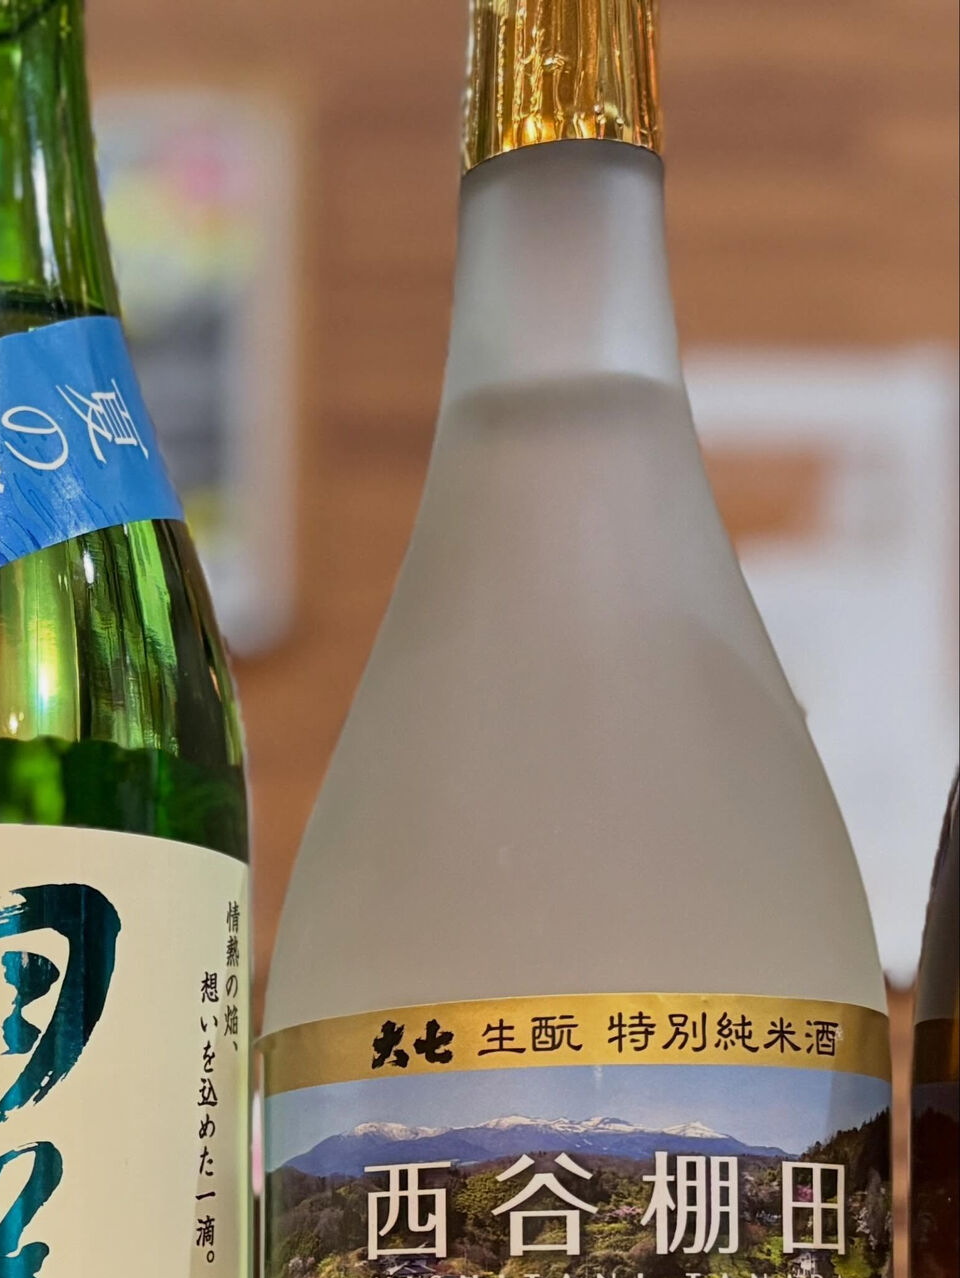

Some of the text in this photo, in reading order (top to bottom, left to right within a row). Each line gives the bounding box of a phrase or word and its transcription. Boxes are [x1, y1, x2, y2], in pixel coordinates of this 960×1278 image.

[608, 1012, 839, 1057] 特別純米酒
[195, 971, 219, 1264] 想いを込めた一滴。
[364, 1151, 846, 1260] 西谷棚田
